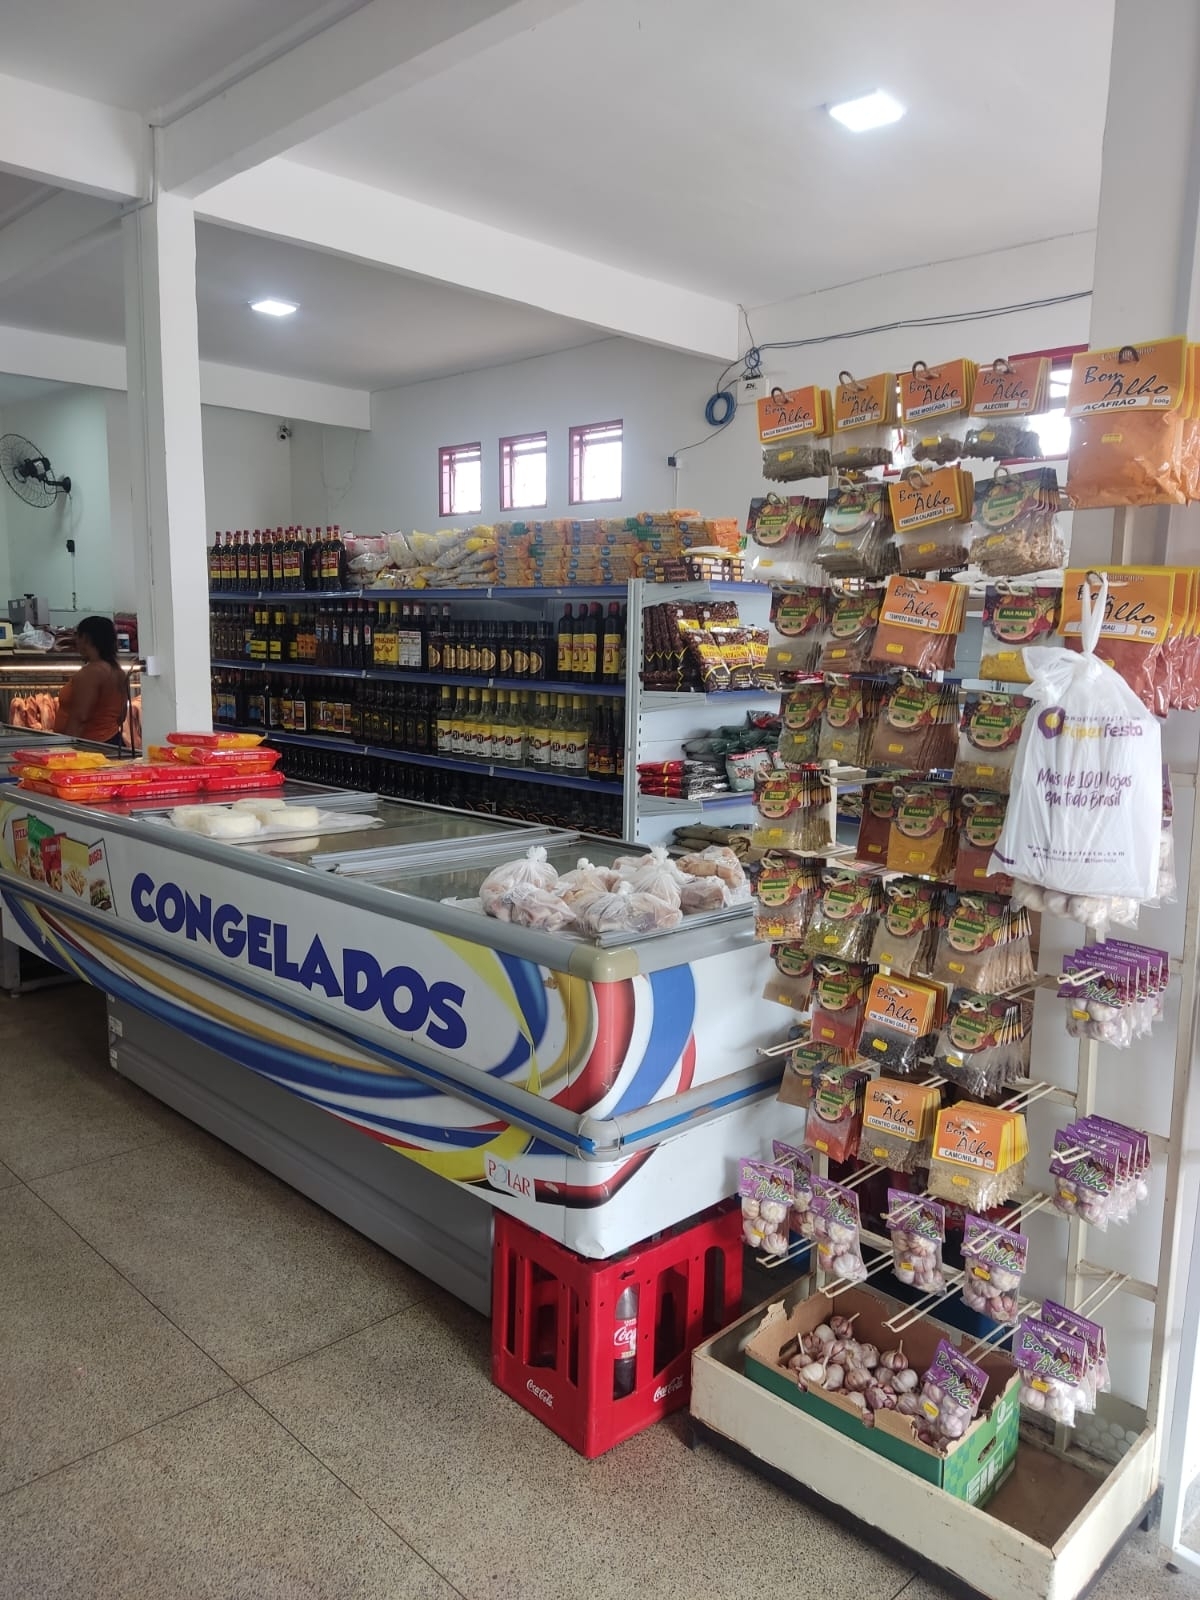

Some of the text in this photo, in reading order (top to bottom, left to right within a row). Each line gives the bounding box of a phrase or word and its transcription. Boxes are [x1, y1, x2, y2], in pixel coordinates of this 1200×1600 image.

[983, 372, 1005, 385] Bom
[1084, 366, 1124, 384] Bom
[841, 391, 857, 403] Bom
[909, 380, 931, 394] Bom
[923, 382, 958, 405] Alho
[993, 381, 1029, 401] Alho
[1102, 375, 1169, 401] Alho
[764, 404, 786, 415] Bom
[778, 406, 810, 425] Alho
[850, 396, 879, 417] Alho
[921, 402, 946, 413] MOSCADA
[899, 490, 921, 502] Bom
[914, 490, 950, 514] Alho
[894, 585, 915, 599] Bom
[903, 599, 939, 620] Alho
[1037, 768, 1132, 791] Mais de 100 lojas
[1045, 790, 1061, 808] em
[1089, 789, 1121, 811] Brasil
[131, 872, 467, 1049] CONGELADOS
[886, 1001, 917, 1023] Alho
[883, 1105, 914, 1126] Alho
[945, 1121, 968, 1136] Bom
[944, 1150, 978, 1163] CAMOMILA
[957, 1137, 992, 1158] Alho
[1067, 1161, 1107, 1191] Alho
[755, 1181, 789, 1202] Alho
[903, 1211, 938, 1239] Alho
[979, 1242, 1018, 1271] Alho
[1023, 1332, 1053, 1356] Bom
[936, 1351, 960, 1378] Bom
[1034, 1354, 1076, 1381] Alho
[937, 1376, 971, 1406] Alho
